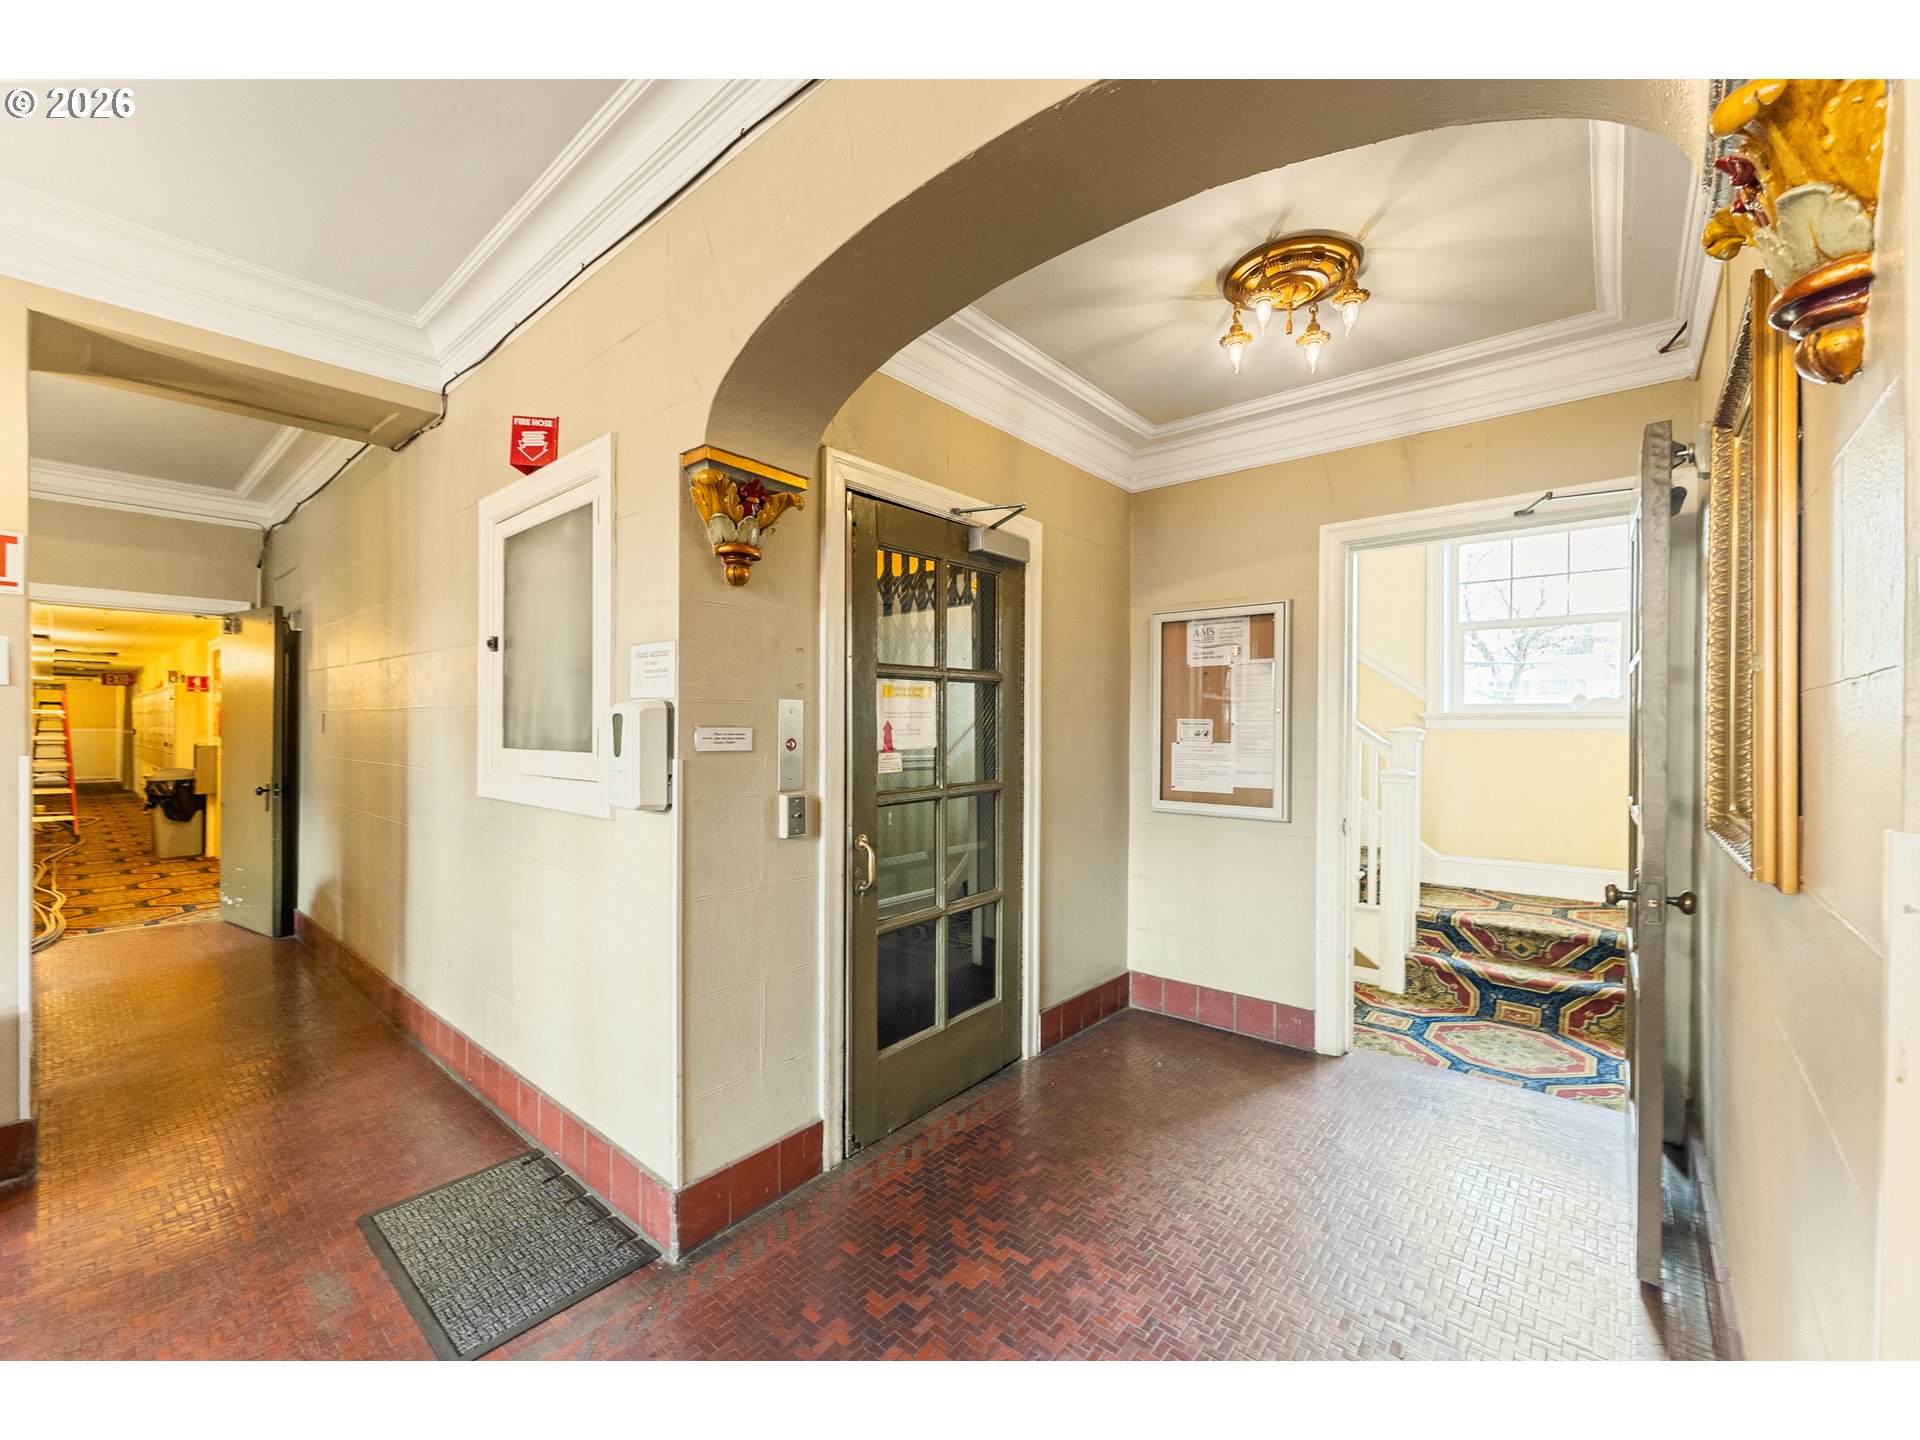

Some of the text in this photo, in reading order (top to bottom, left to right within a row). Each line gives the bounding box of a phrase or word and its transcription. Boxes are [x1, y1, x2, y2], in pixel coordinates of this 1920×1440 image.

[513, 417, 553, 428] FIRE HOSE
[1192, 626, 1216, 638] AMS
